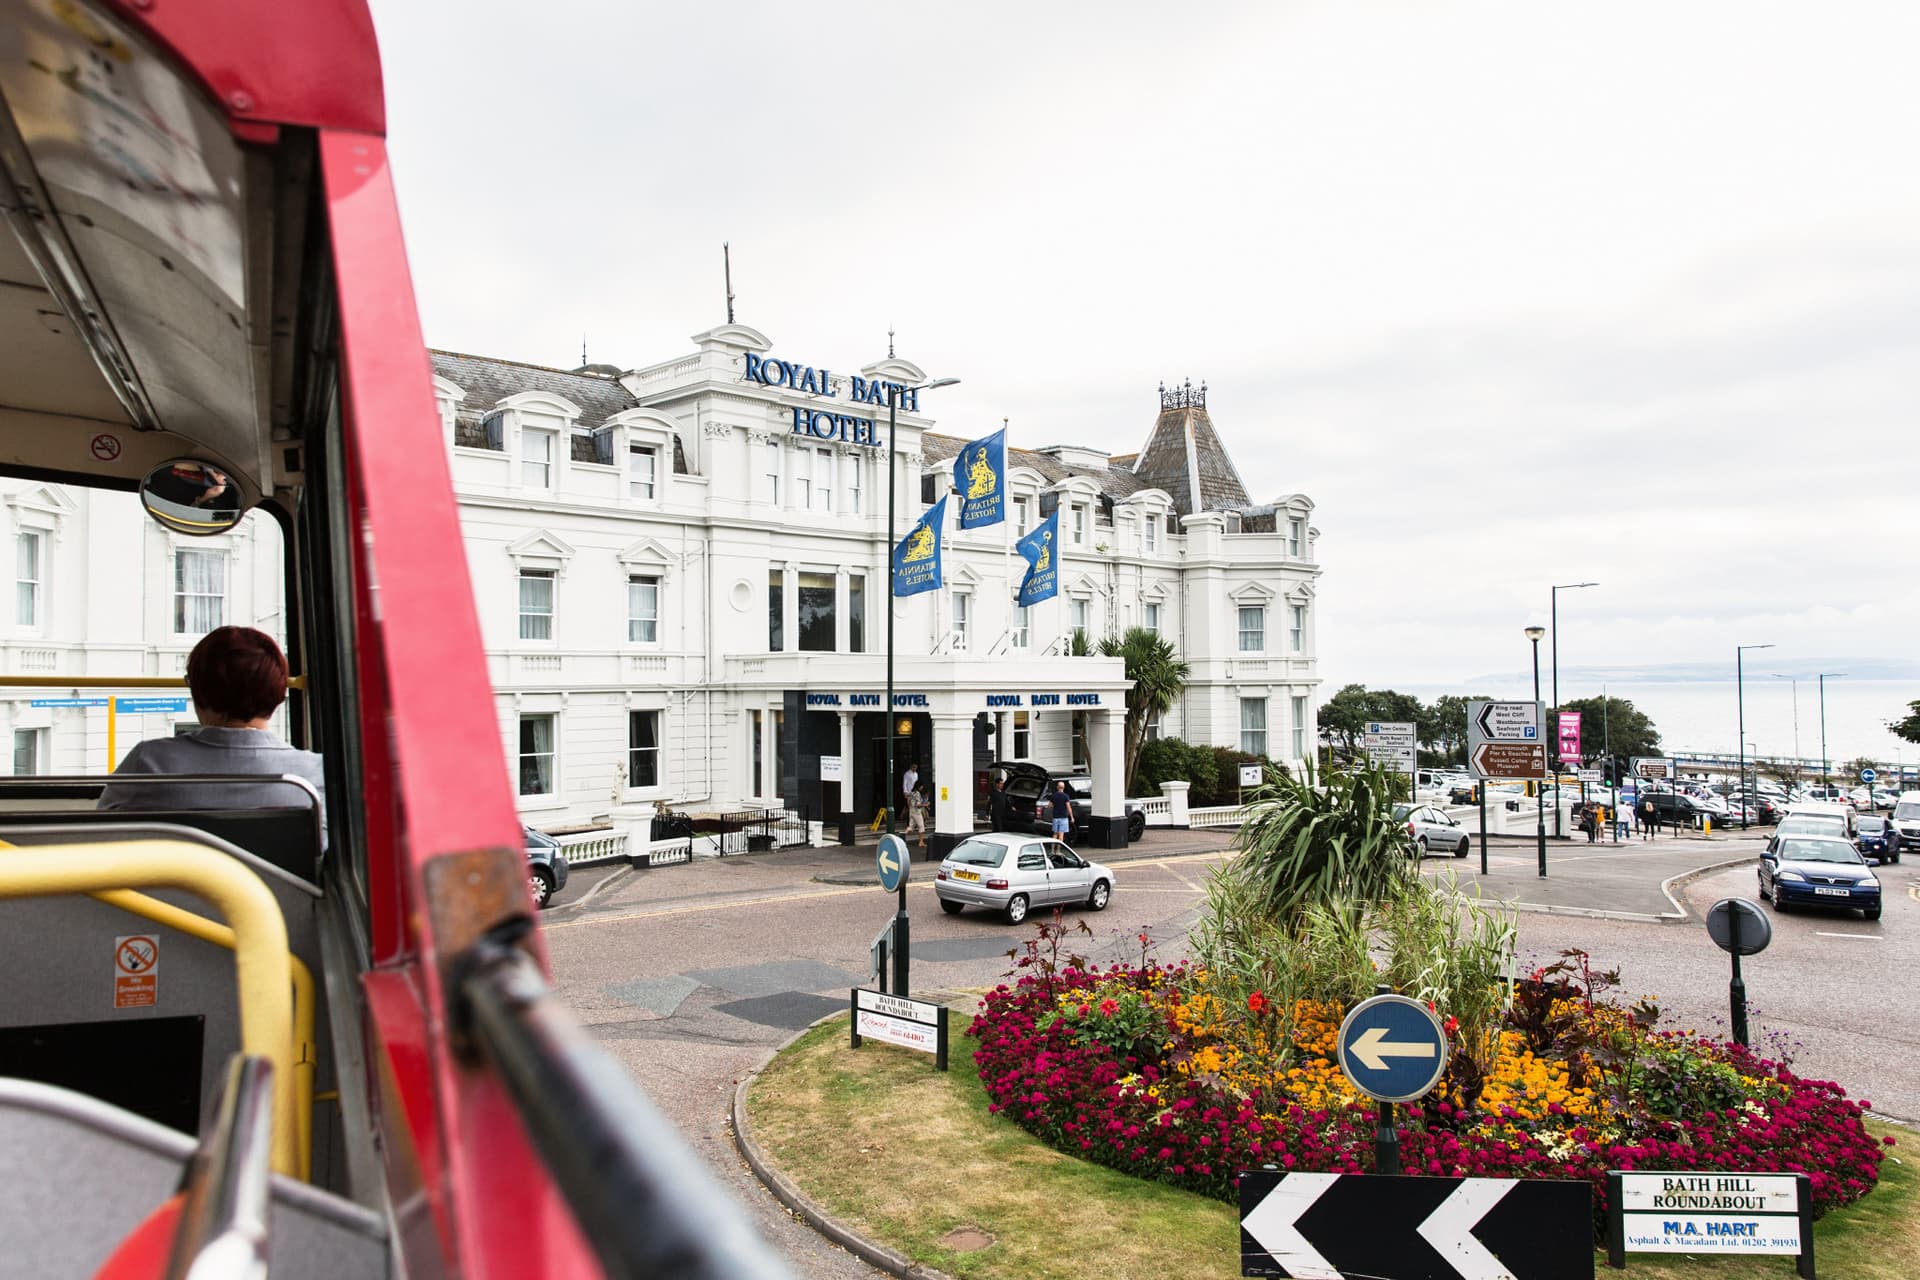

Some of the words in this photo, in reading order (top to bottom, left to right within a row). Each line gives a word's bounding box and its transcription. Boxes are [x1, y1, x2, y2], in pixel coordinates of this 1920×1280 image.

[744, 352, 836, 398] ROYAL
[850, 375, 920, 412] BATH
[792, 407, 882, 446] HOTEL
[806, 694, 842, 706] ROYAL
[849, 694, 880, 706] BATH
[986, 695, 1023, 707] ROYAL
[1031, 694, 1060, 706] BATH
[1066, 694, 1102, 705] HOTEL
[879, 995, 897, 1006] BATH
[897, 999, 914, 1010] HILL
[874, 1002, 919, 1019] ROUNDABOUT
[1662, 1177, 1710, 1192] BATH
[1716, 1178, 1756, 1193] HILL
[1653, 1195, 1767, 1210] ROUNDABOUT
[1663, 1221, 1704, 1236] M.A.
[1706, 1222, 1760, 1237] HART
[1626, 1236, 1660, 1246] Asphalt
[1663, 1237, 1672, 1246] &
[1675, 1236, 1718, 1247] Macadam
[1721, 1237, 1740, 1247] Ltd.
[1741, 1237, 1767, 1247] 01202
[1769, 1238, 1798, 1248] 391931
